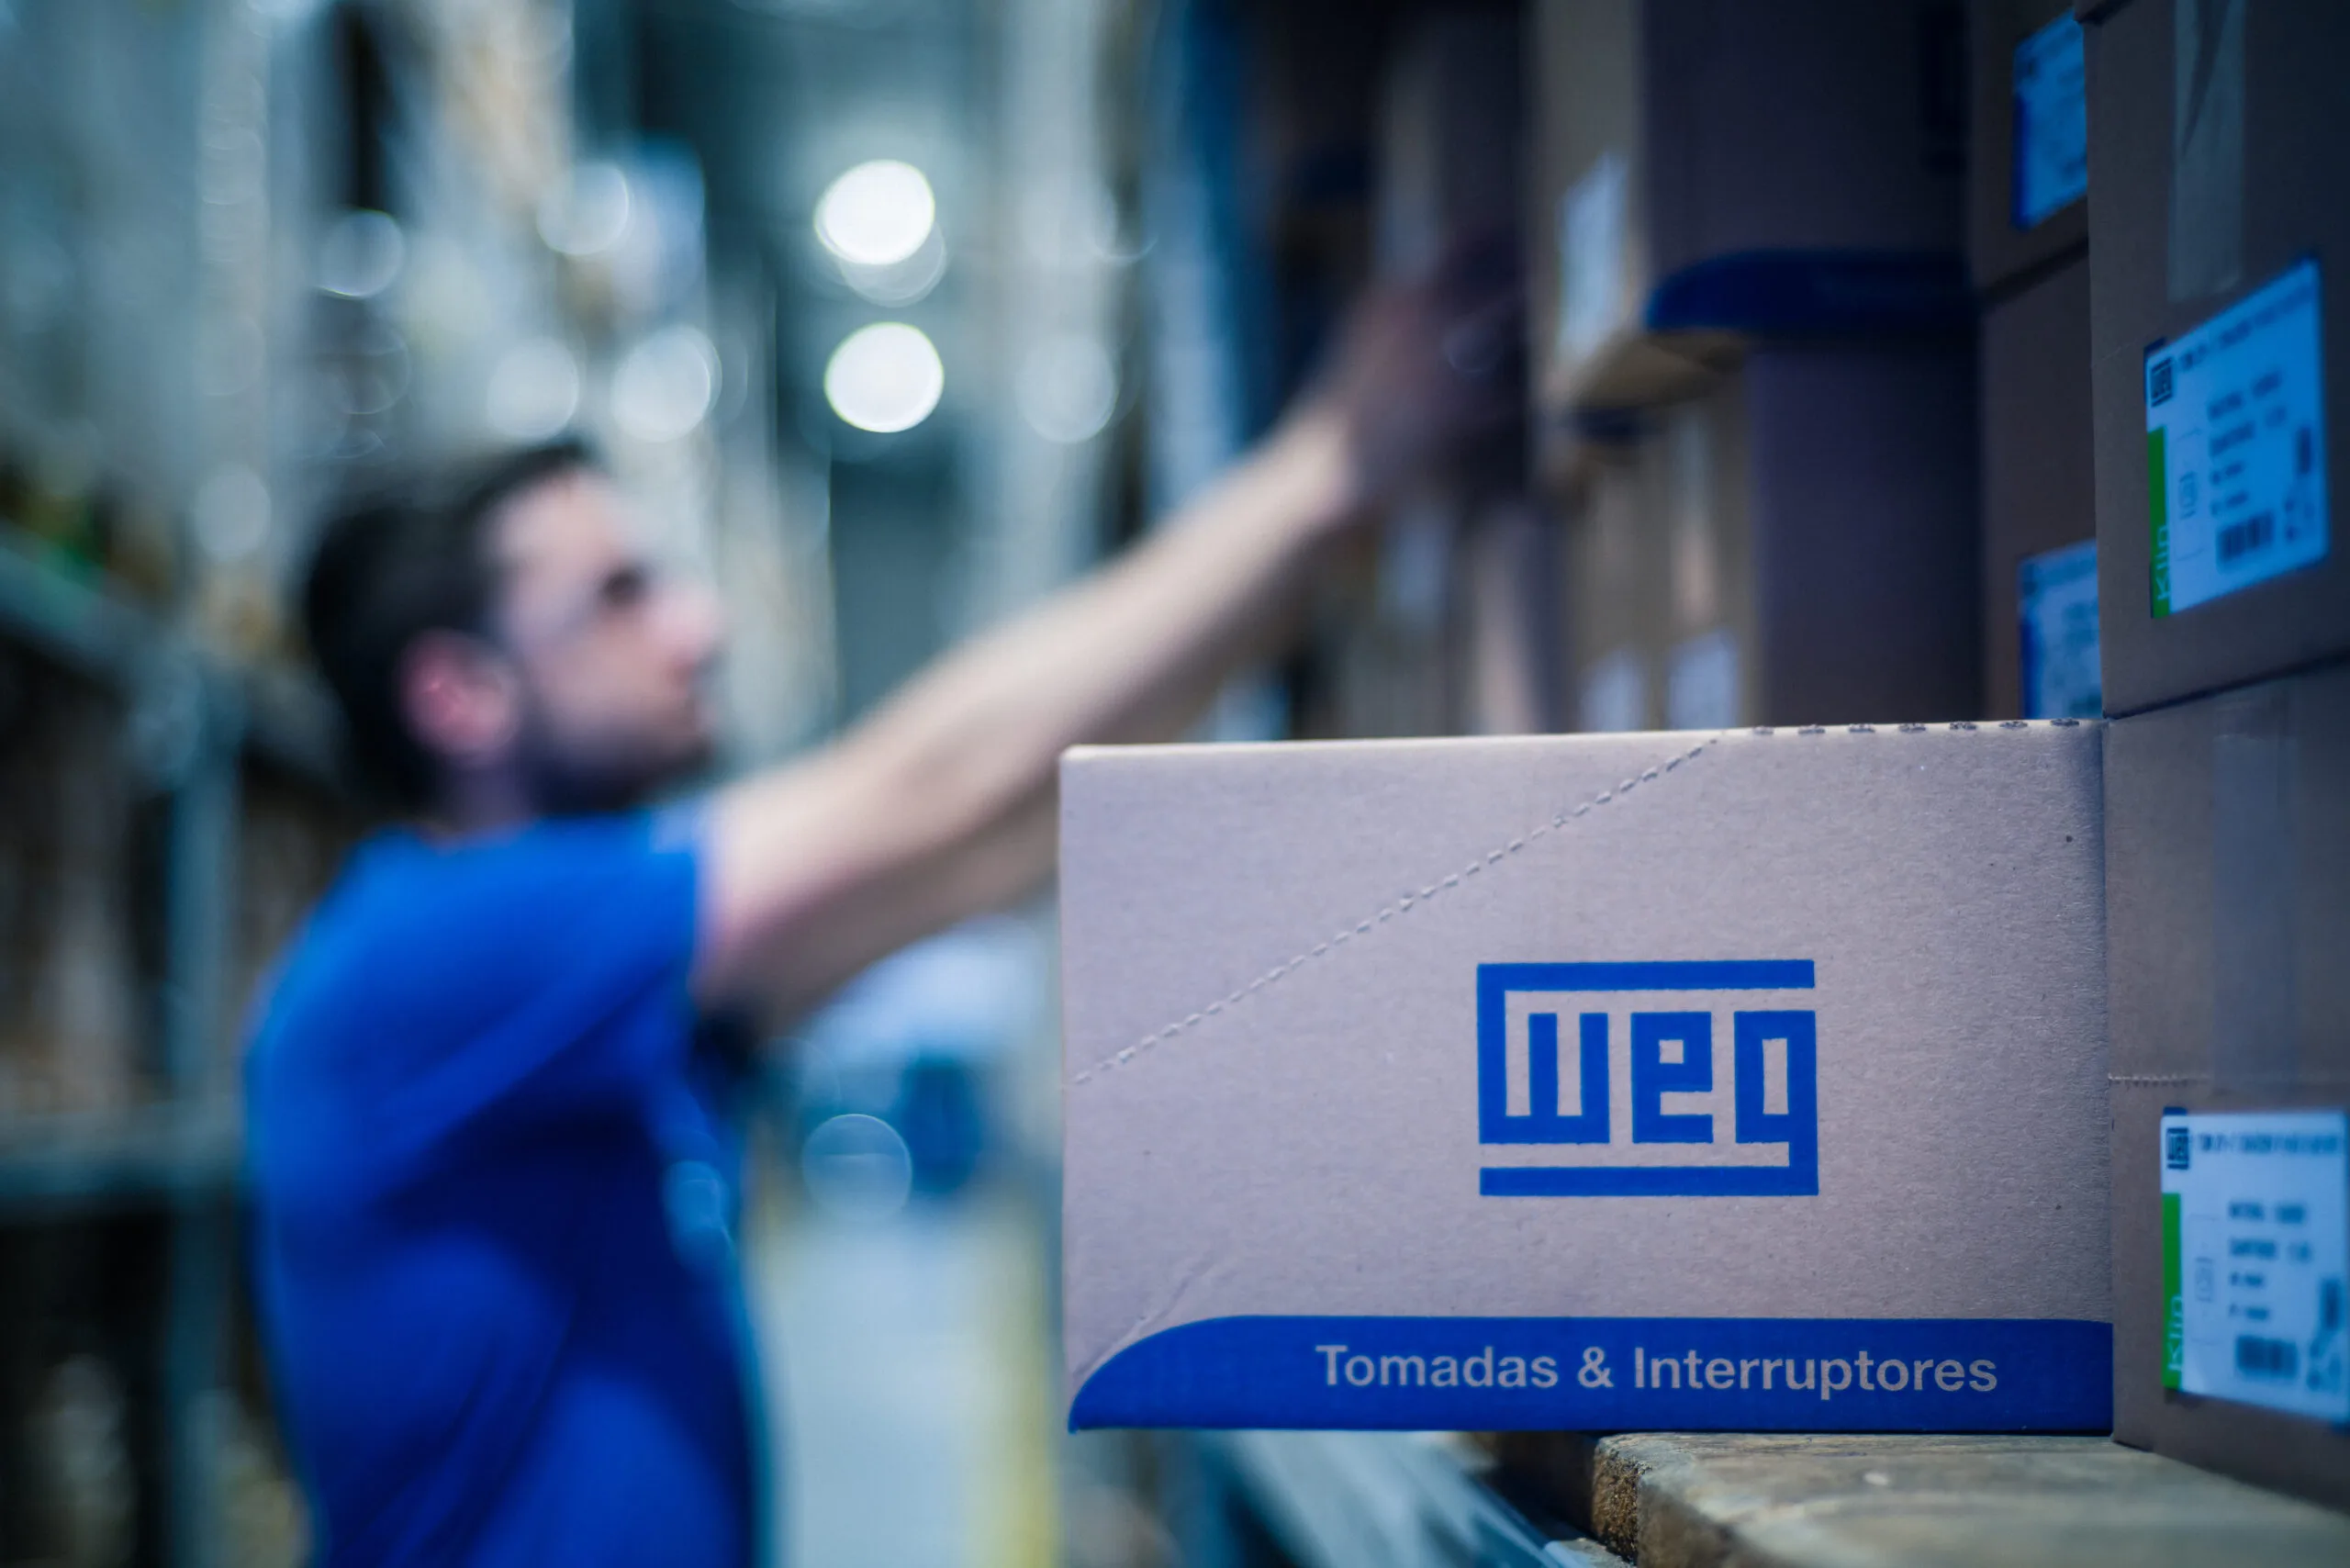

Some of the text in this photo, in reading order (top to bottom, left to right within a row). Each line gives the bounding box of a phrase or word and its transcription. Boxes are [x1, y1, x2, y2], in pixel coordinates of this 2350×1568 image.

[1316, 1345, 1997, 1400] Tomadas & Interruptores
